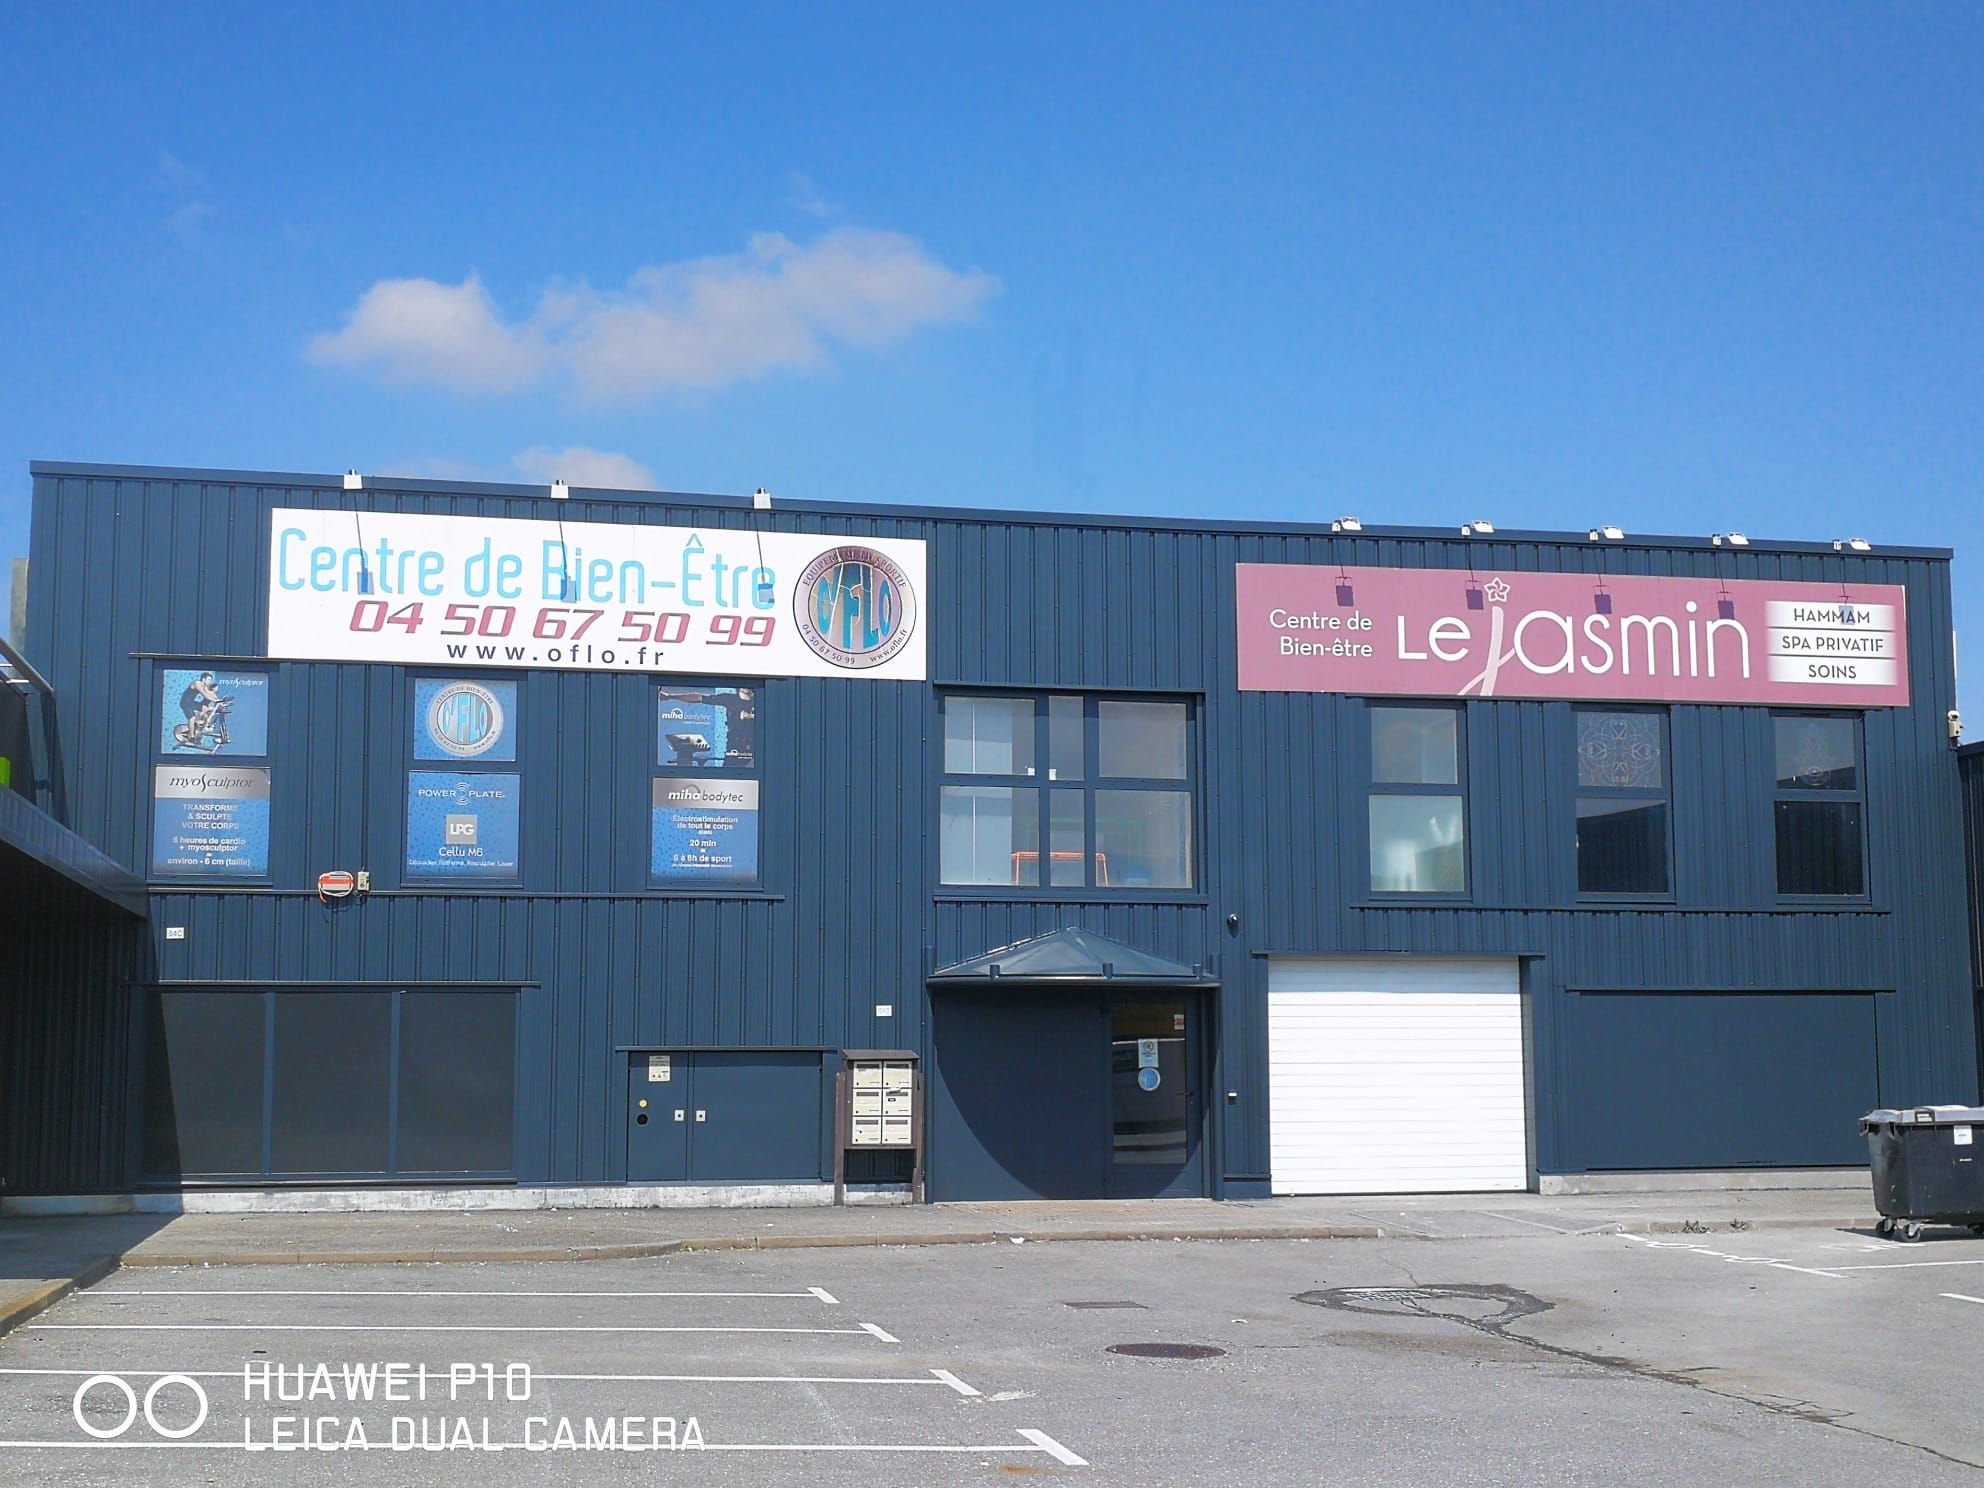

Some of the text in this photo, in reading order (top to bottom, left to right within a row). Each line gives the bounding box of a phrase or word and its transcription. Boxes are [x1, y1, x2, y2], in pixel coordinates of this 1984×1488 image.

[278, 528, 777, 609] Centre de Bien-Être
[1269, 607, 1372, 632] Centre de
[1792, 607, 1871, 625] HAMMAM
[349, 601, 776, 647] 04 50 67 50 99
[1280, 636, 1373, 658] Bien-être
[1781, 635, 1884, 653] SPA PRIVATIF
[447, 639, 665, 667] www.oflo.fr
[1808, 664, 1856, 680] SOINS
[418, 789, 457, 798] POWER
[668, 787, 744, 804] miha bodytec
[183, 803, 239, 812] TRANSFORME
[195, 812, 233, 821] SCULPTE
[182, 821, 240, 830] VOTRE CORPS
[449, 823, 475, 836] LPG
[180, 836, 207, 844] heures
[208, 836, 219, 844] de
[220, 837, 246, 845] cardio
[701, 839, 717, 847] min
[187, 845, 239, 854] myosculptor
[438, 846, 484, 857] Cellu M6
[167, 857, 198, 865] environ
[710, 855, 732, 864] sport
